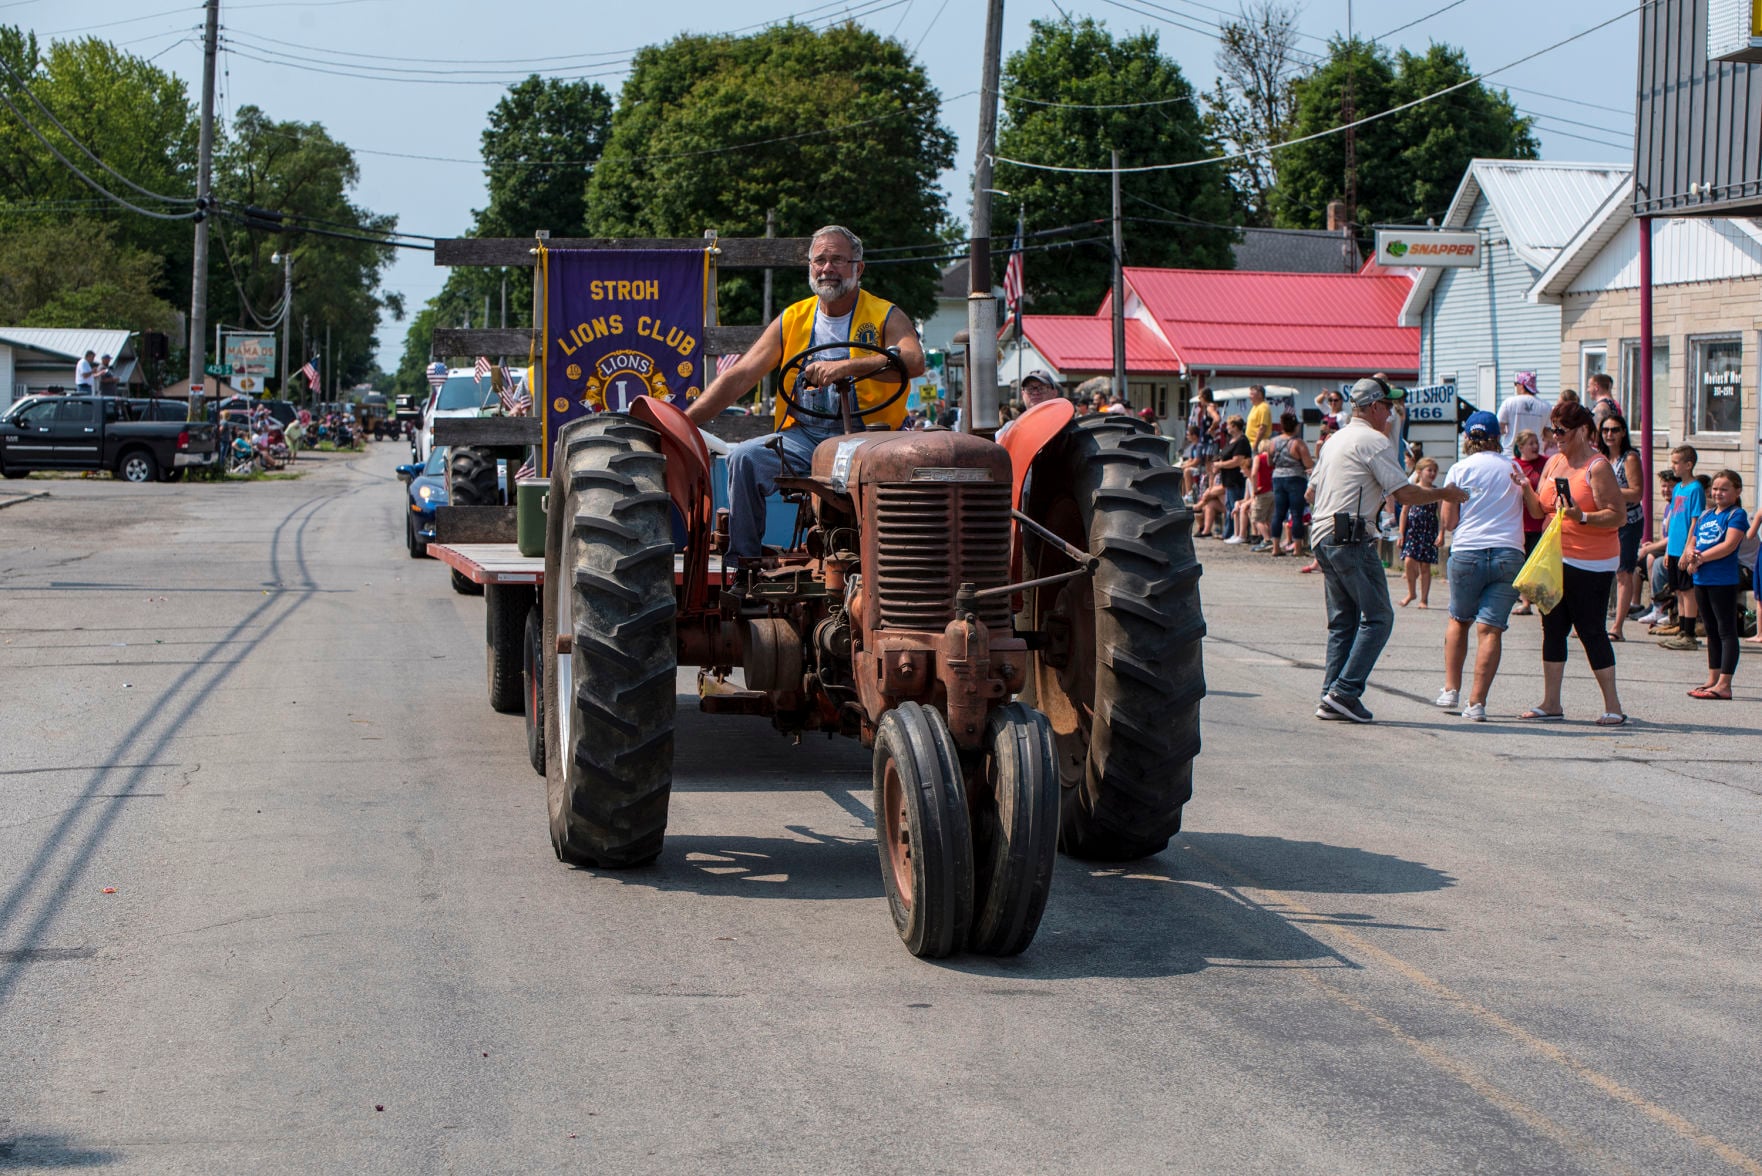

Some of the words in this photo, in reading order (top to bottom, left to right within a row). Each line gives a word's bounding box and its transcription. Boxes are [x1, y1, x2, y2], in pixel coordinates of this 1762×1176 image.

[1408, 243, 1476, 256] SNAPPER
[590, 279, 659, 301] STROH
[557, 314, 624, 356] LIONS
[637, 315, 696, 356] CLUB
[600, 355, 650, 375] LIONS
[615, 381, 630, 413] L
[1423, 385, 1454, 403] SHOP
[1406, 407, 1443, 419] 166
